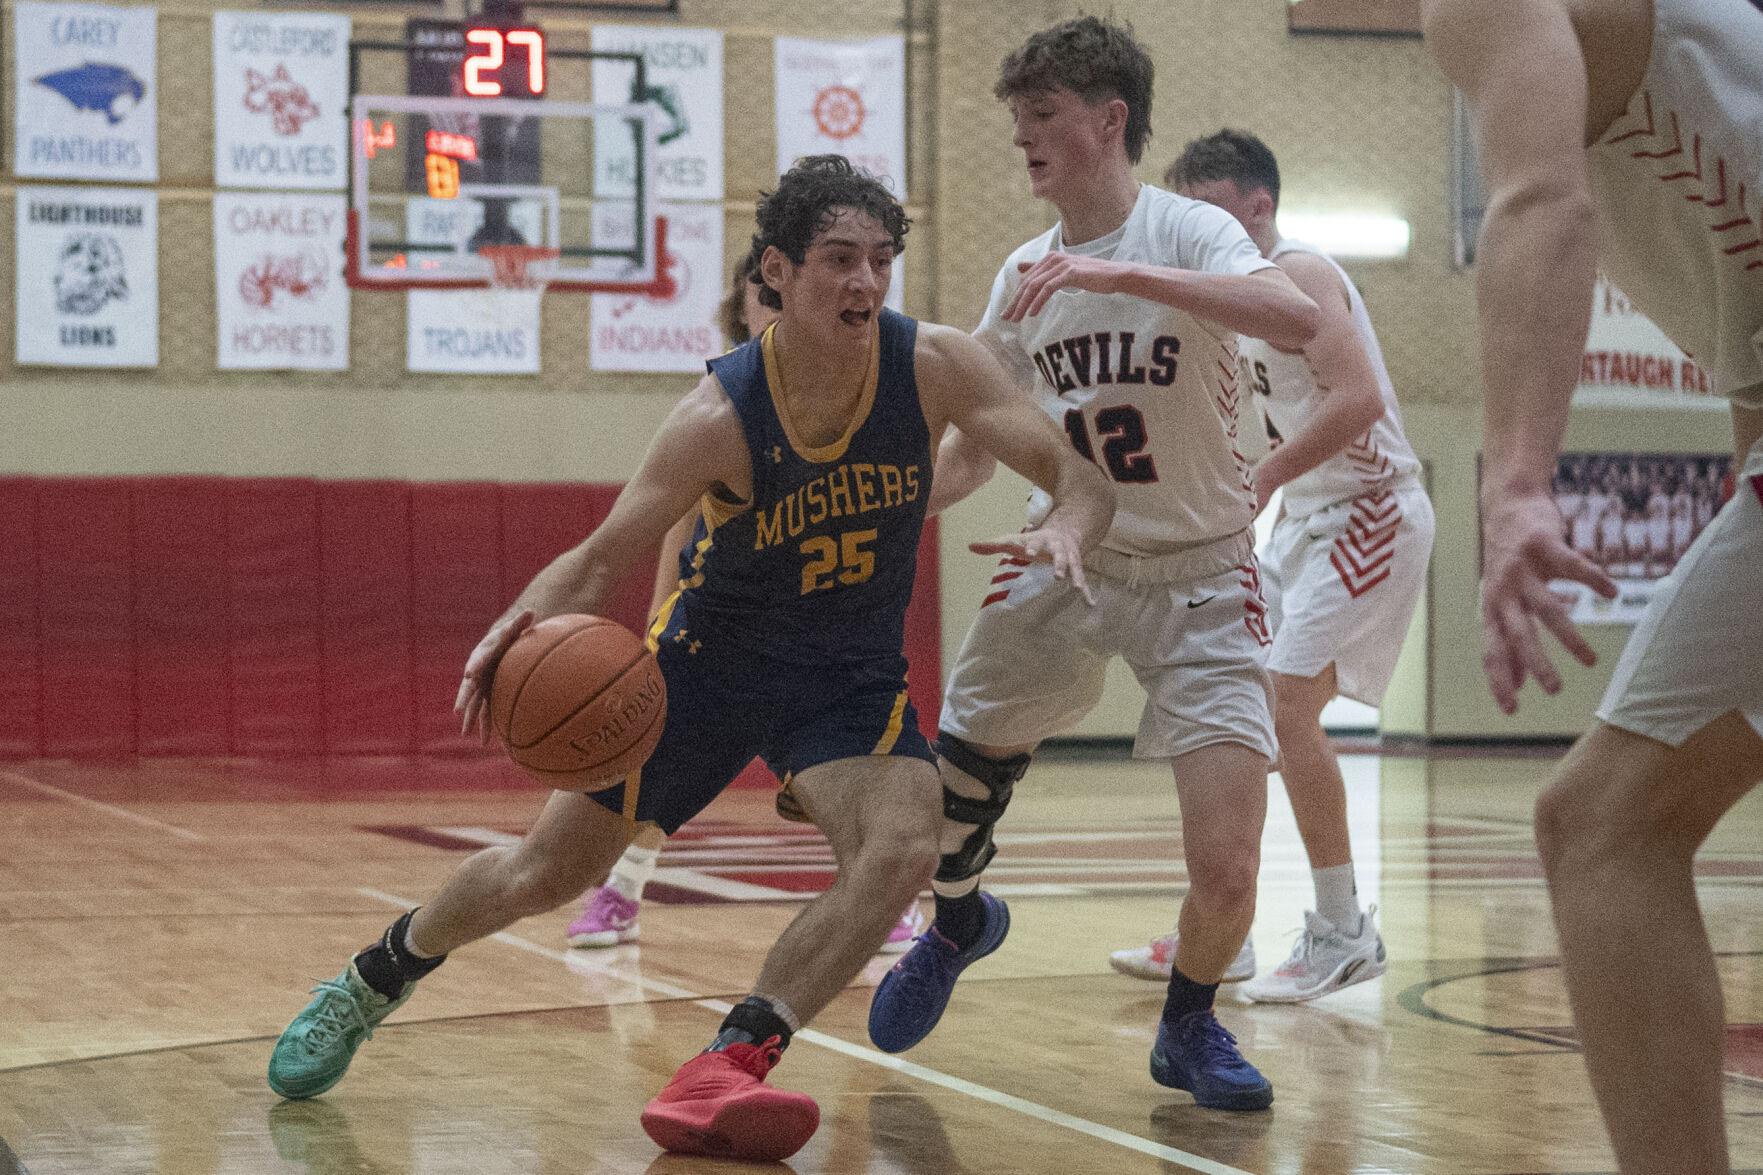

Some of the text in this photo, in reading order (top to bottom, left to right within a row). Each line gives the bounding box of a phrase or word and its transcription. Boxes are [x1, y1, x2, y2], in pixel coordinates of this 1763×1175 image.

[51, 17, 122, 47] CAREY
[464, 27, 543, 95] 27
[31, 136, 142, 167] PANTHERS
[231, 145, 337, 175] WOLVES
[29, 202, 144, 227] LIGHTHOUSE
[229, 205, 337, 236] OAKLEY
[59, 325, 116, 347] LIONS
[232, 324, 336, 355] HORNETS
[424, 327, 526, 358] TROJANS
[599, 326, 712, 352] INDIANS
[1033, 331, 1180, 397] DEVILS
[1064, 404, 1159, 484] 12
[755, 464, 919, 550] MUSHERS
[800, 528, 878, 596] 25
